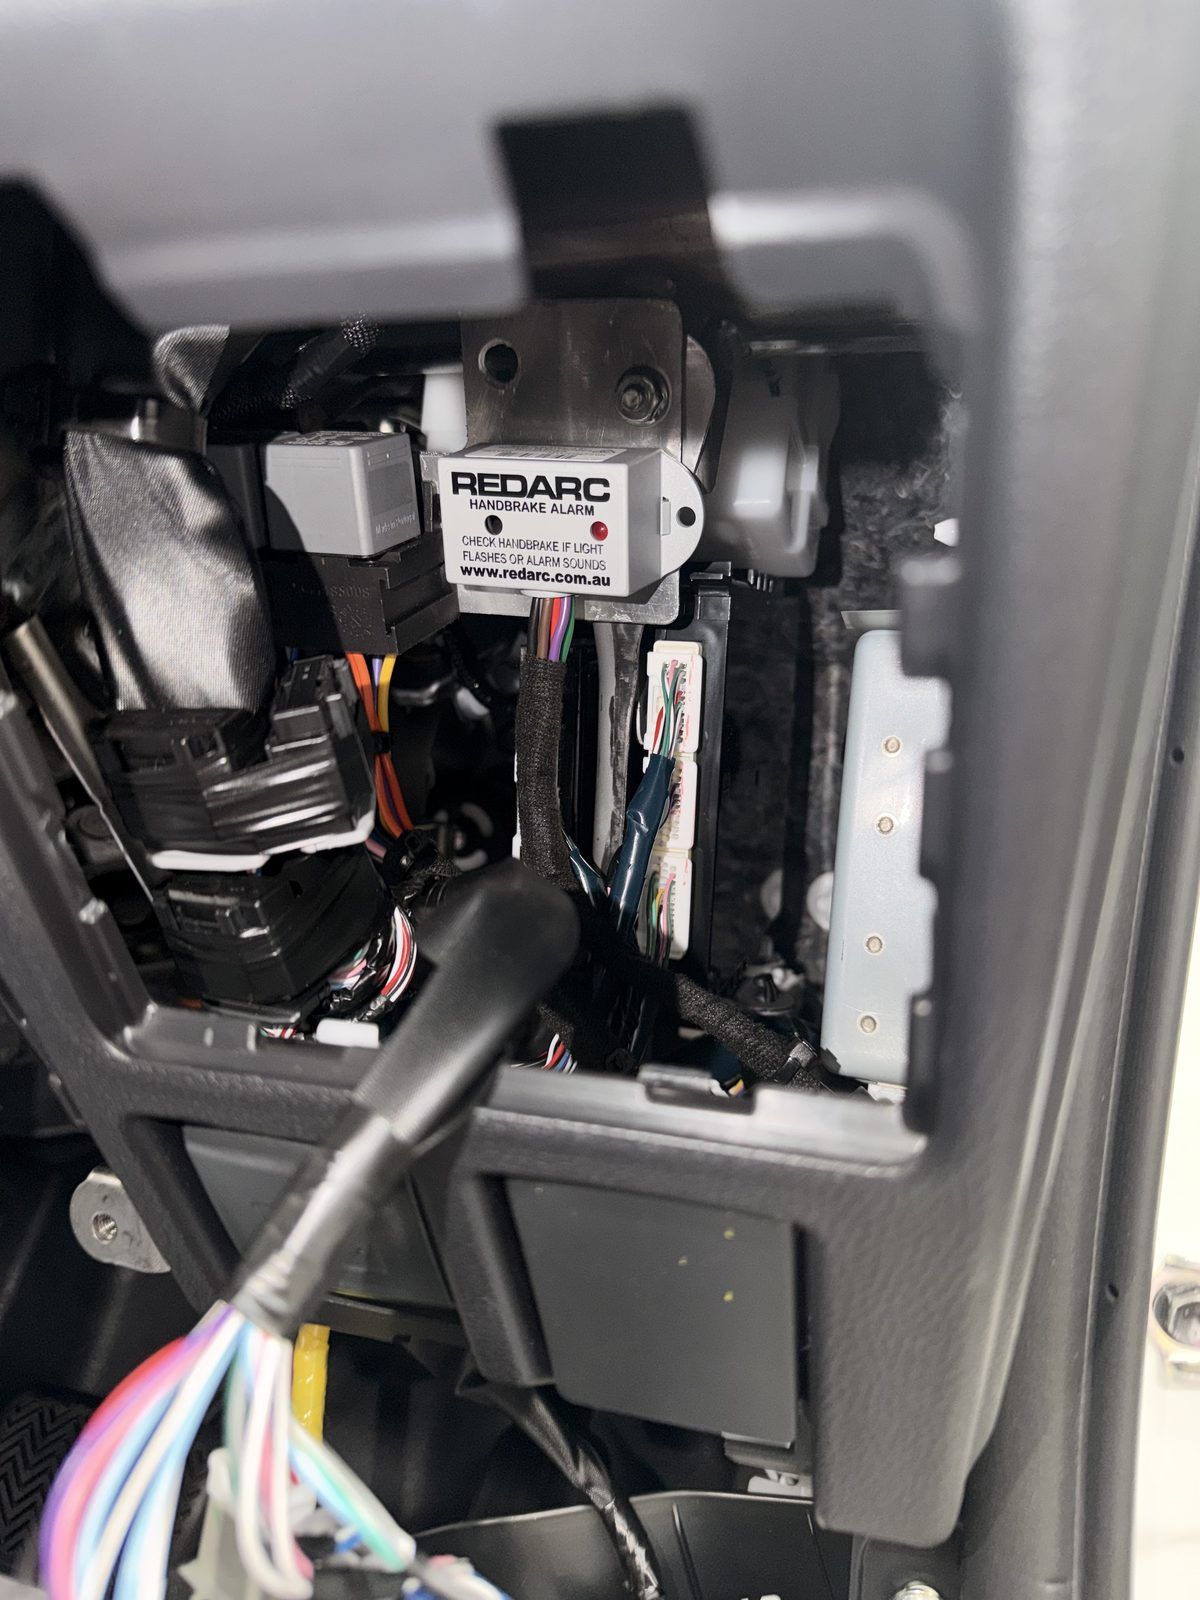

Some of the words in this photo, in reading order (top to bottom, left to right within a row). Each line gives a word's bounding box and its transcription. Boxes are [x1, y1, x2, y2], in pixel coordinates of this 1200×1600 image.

[451, 471, 610, 502] REDARC
[470, 498, 547, 514] HANDBRAKE
[550, 503, 594, 516] ALARM
[462, 535, 497, 548] CHECK
[498, 537, 559, 552] HANDBRAKE
[562, 542, 571, 552] IF
[573, 543, 604, 554] LIGHT
[463, 550, 507, 565] FLASHES
[509, 553, 524, 565] OR
[526, 555, 561, 568] ALARM
[563, 557, 606, 571] SOUNDS
[460, 565, 611, 587] www.redarc.com.au
